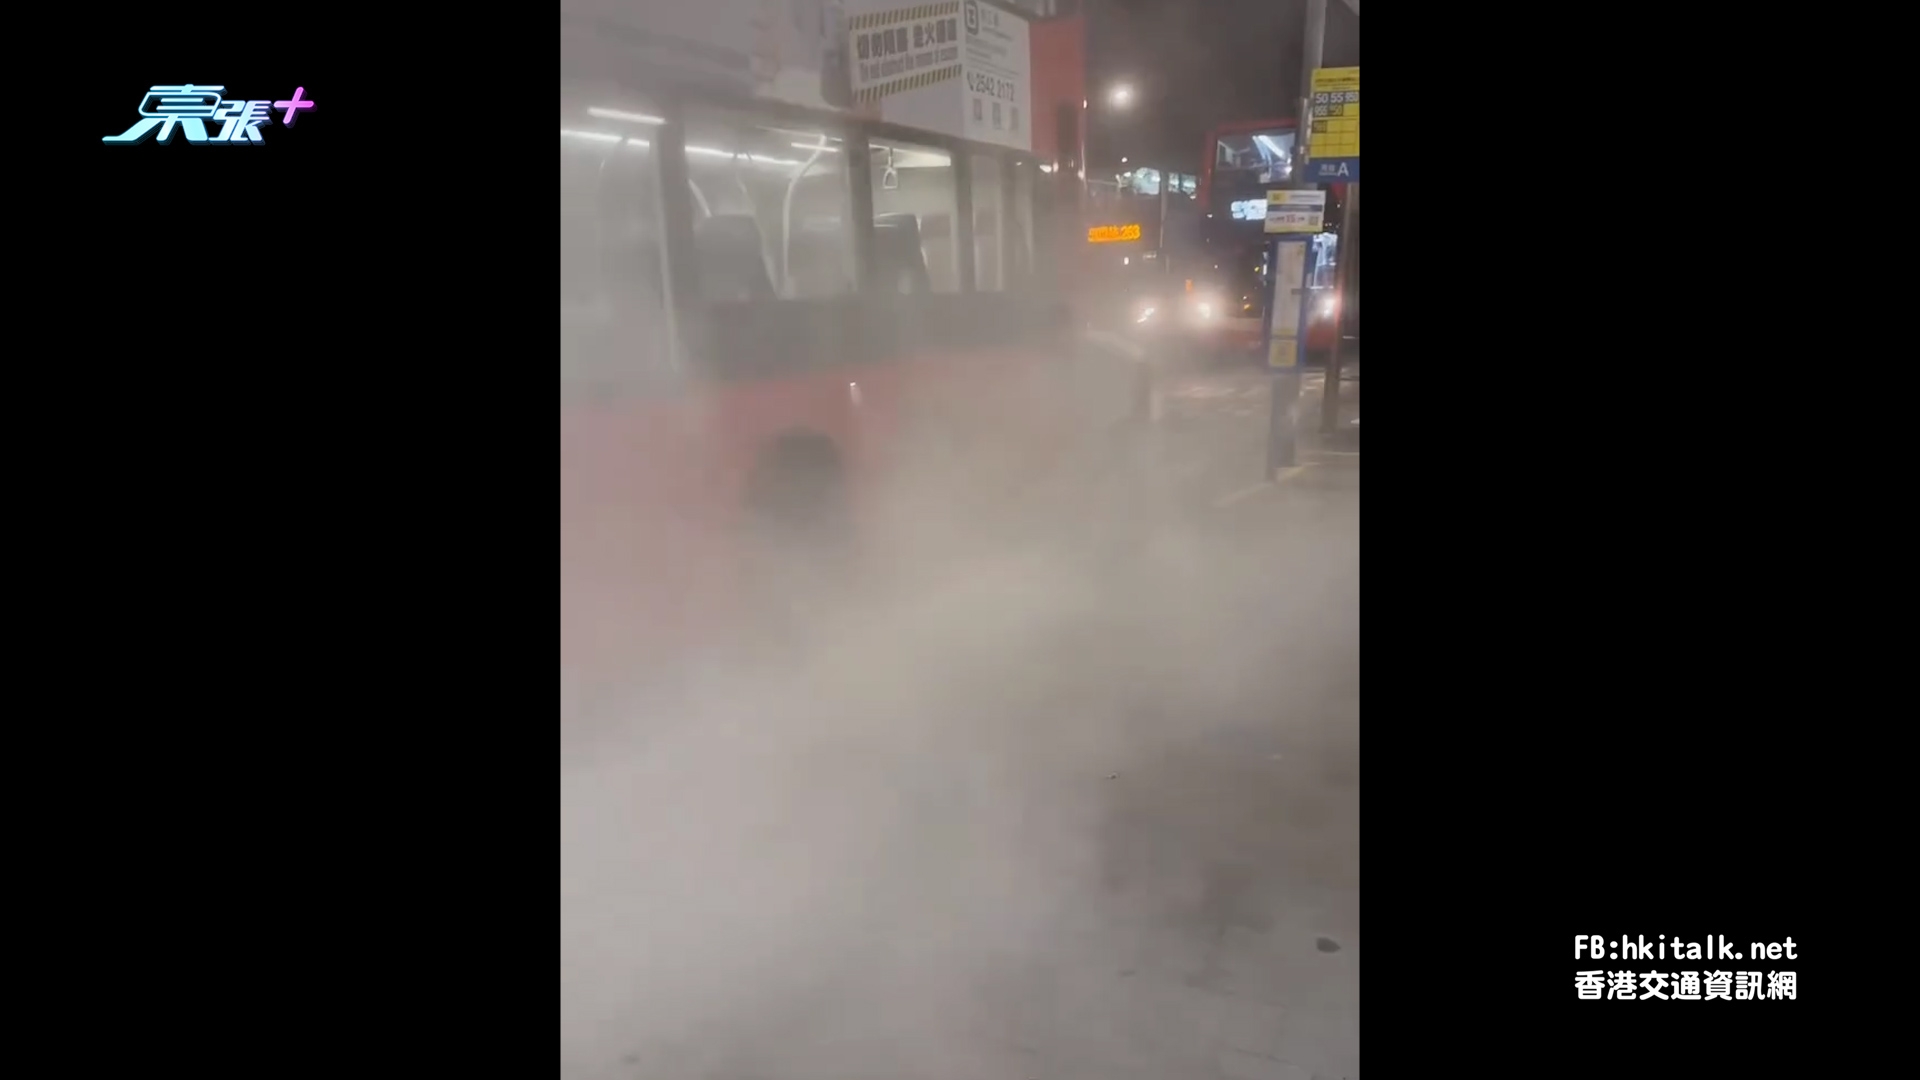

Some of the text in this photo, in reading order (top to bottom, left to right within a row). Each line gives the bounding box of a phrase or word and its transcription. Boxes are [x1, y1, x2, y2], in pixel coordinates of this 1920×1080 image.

[1315, 92, 1329, 104] 50
[1330, 91, 1344, 104] 55
[1337, 161, 1349, 177] A
